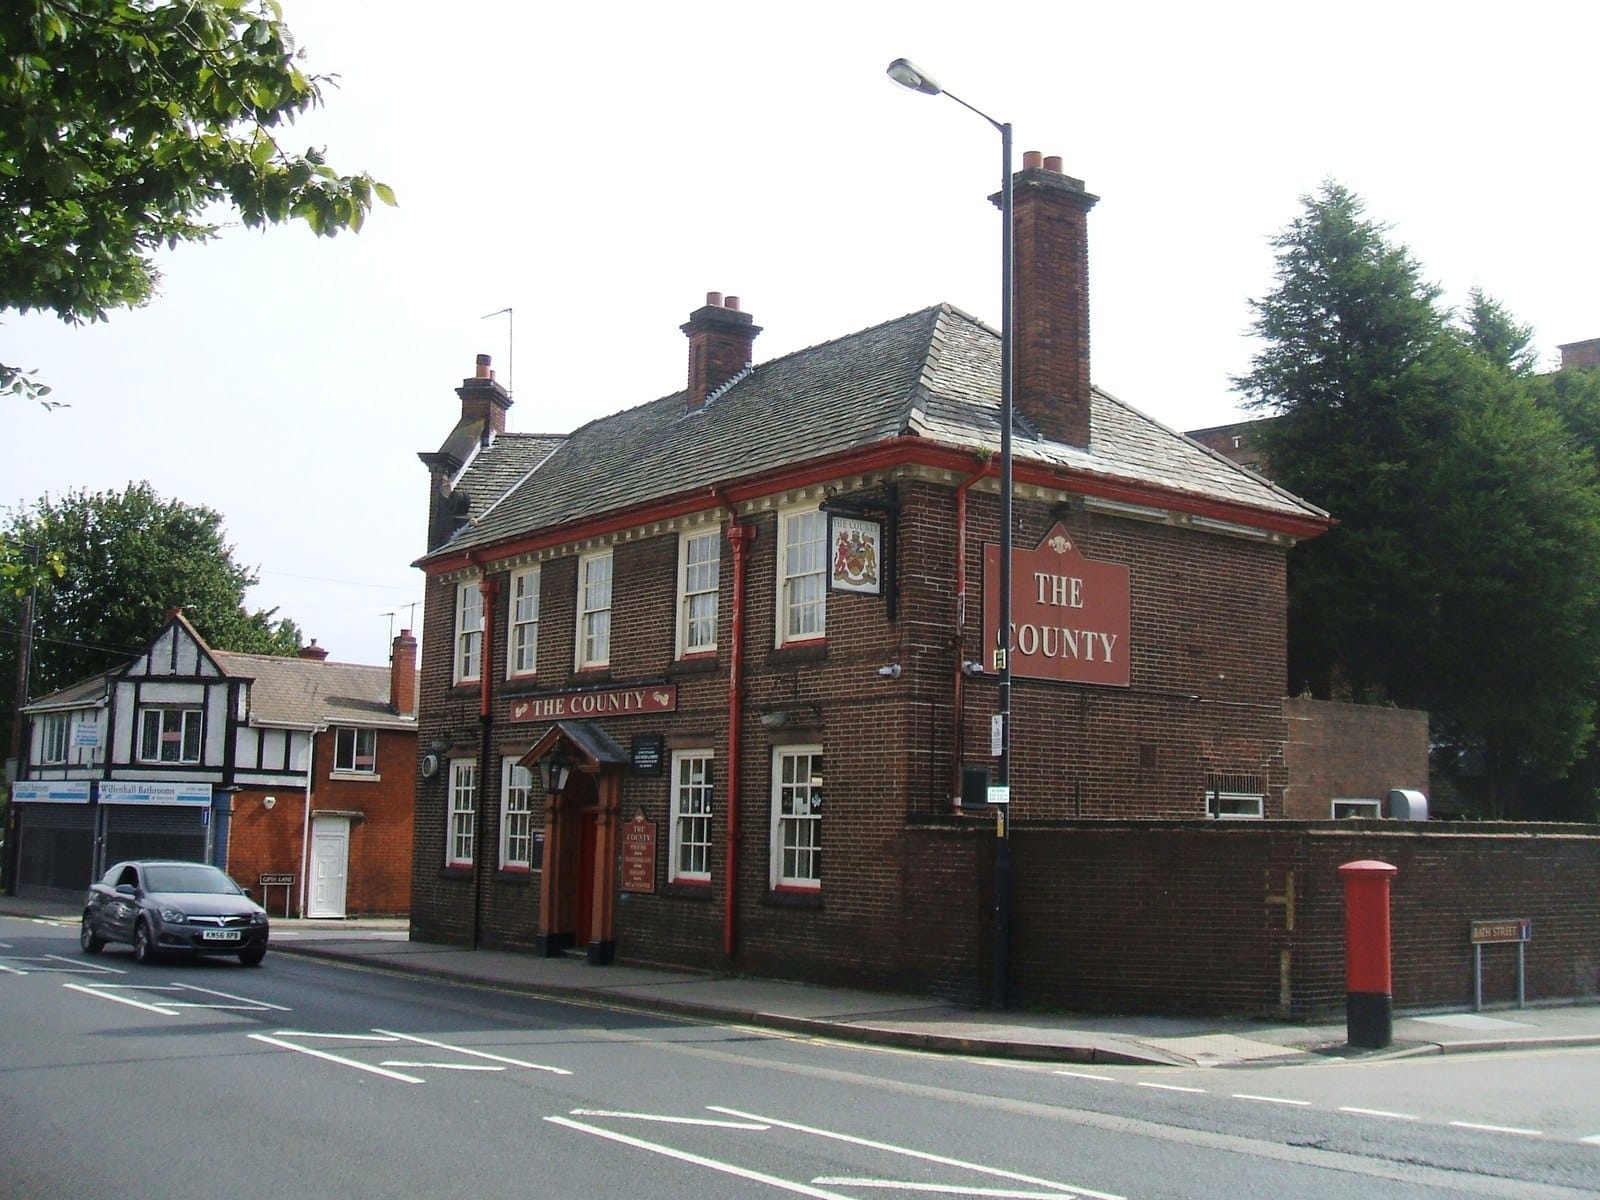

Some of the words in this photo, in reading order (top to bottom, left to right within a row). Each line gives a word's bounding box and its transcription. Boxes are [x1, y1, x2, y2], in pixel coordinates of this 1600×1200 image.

[1034, 572, 1084, 609] THE
[532, 697, 565, 717] THE
[570, 690, 647, 714] COUNTY
[1493, 926, 1517, 937] STREET
